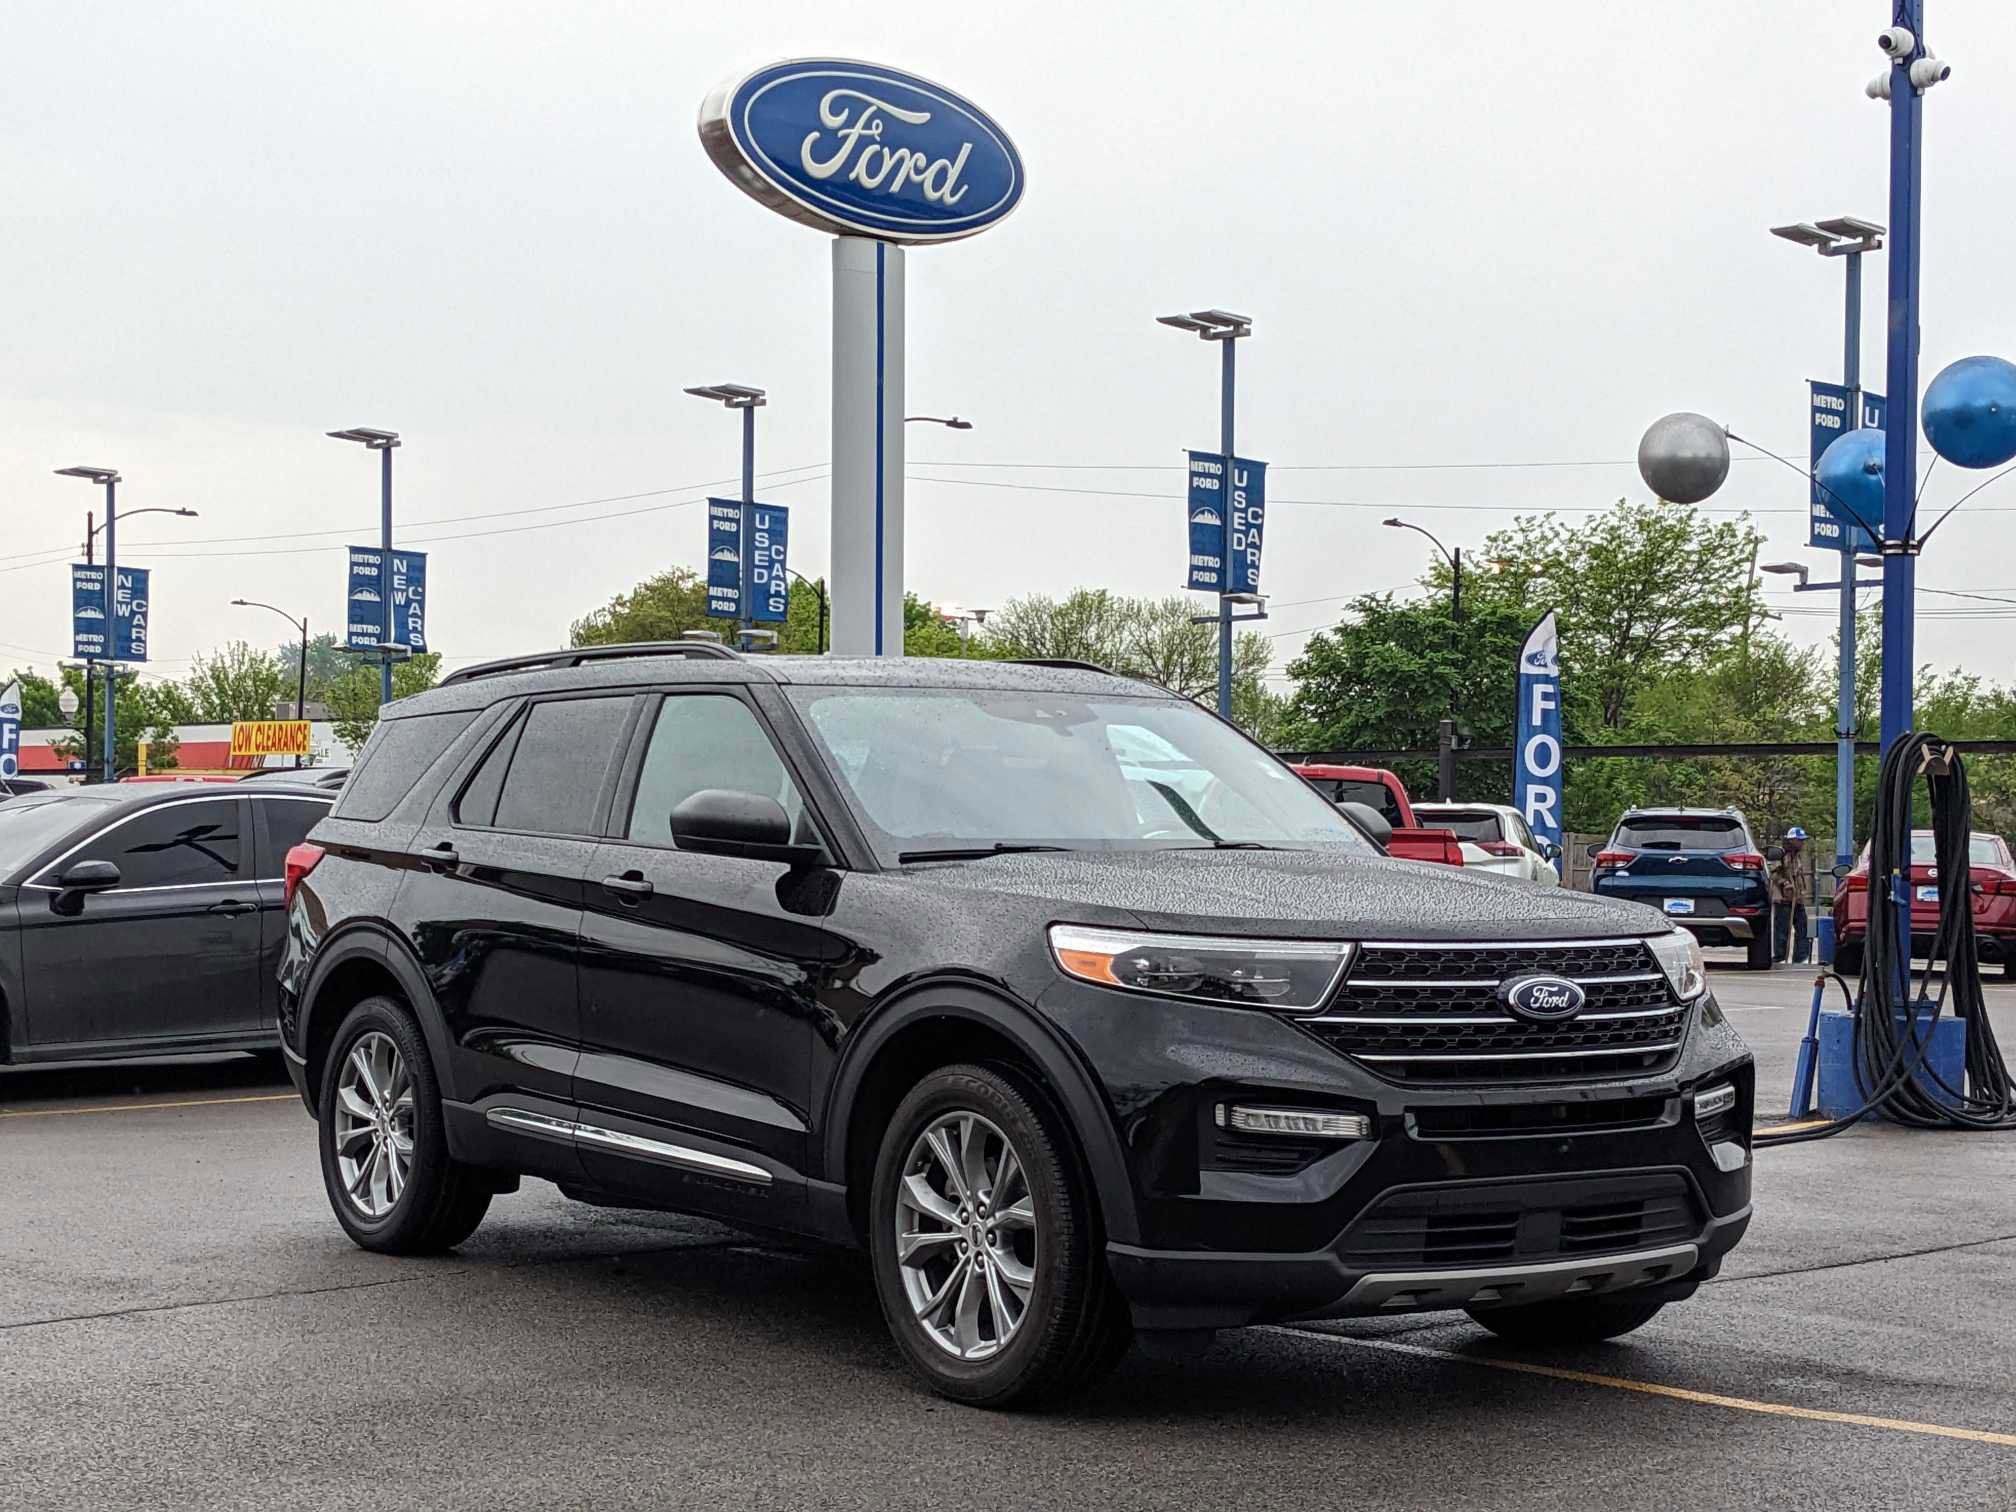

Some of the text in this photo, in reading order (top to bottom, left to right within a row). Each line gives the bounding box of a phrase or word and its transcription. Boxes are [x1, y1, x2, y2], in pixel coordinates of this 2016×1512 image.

[801, 89, 973, 205] Ford
[1813, 393, 1845, 411] METRO
[1815, 413, 1841, 429] FORD
[1190, 460, 1222, 475] METRO
[1192, 477, 1219, 490] FORD
[710, 506, 739, 519] METRO
[1233, 468, 1248, 551] USED
[713, 520, 737, 532] FORD
[1814, 523, 1840, 537] FORD
[753, 513, 769, 583] USED
[1246, 507, 1262, 586] CARS
[351, 554, 381, 564] METRO
[1190, 554, 1220, 568] METRO
[73, 571, 103, 580] METRO
[353, 566, 378, 576] FORD
[768, 544, 785, 612] CARS
[1192, 571, 1218, 583] FORD
[76, 581, 101, 590] FORD
[393, 558, 407, 605] NEW
[117, 575, 132, 617] NEW
[709, 586, 739, 598] METRO
[711, 600, 736, 612] FORD
[408, 586, 424, 646] CARS
[131, 600, 147, 654] CARS
[349, 624, 380, 634] METRO
[351, 635, 377, 646] FORD
[78, 645, 101, 653] FORD
[232, 723, 307, 752] LOW CLEARANCE
[0, 723, 17, 779] FO
[1530, 985, 1569, 1009] Ford
